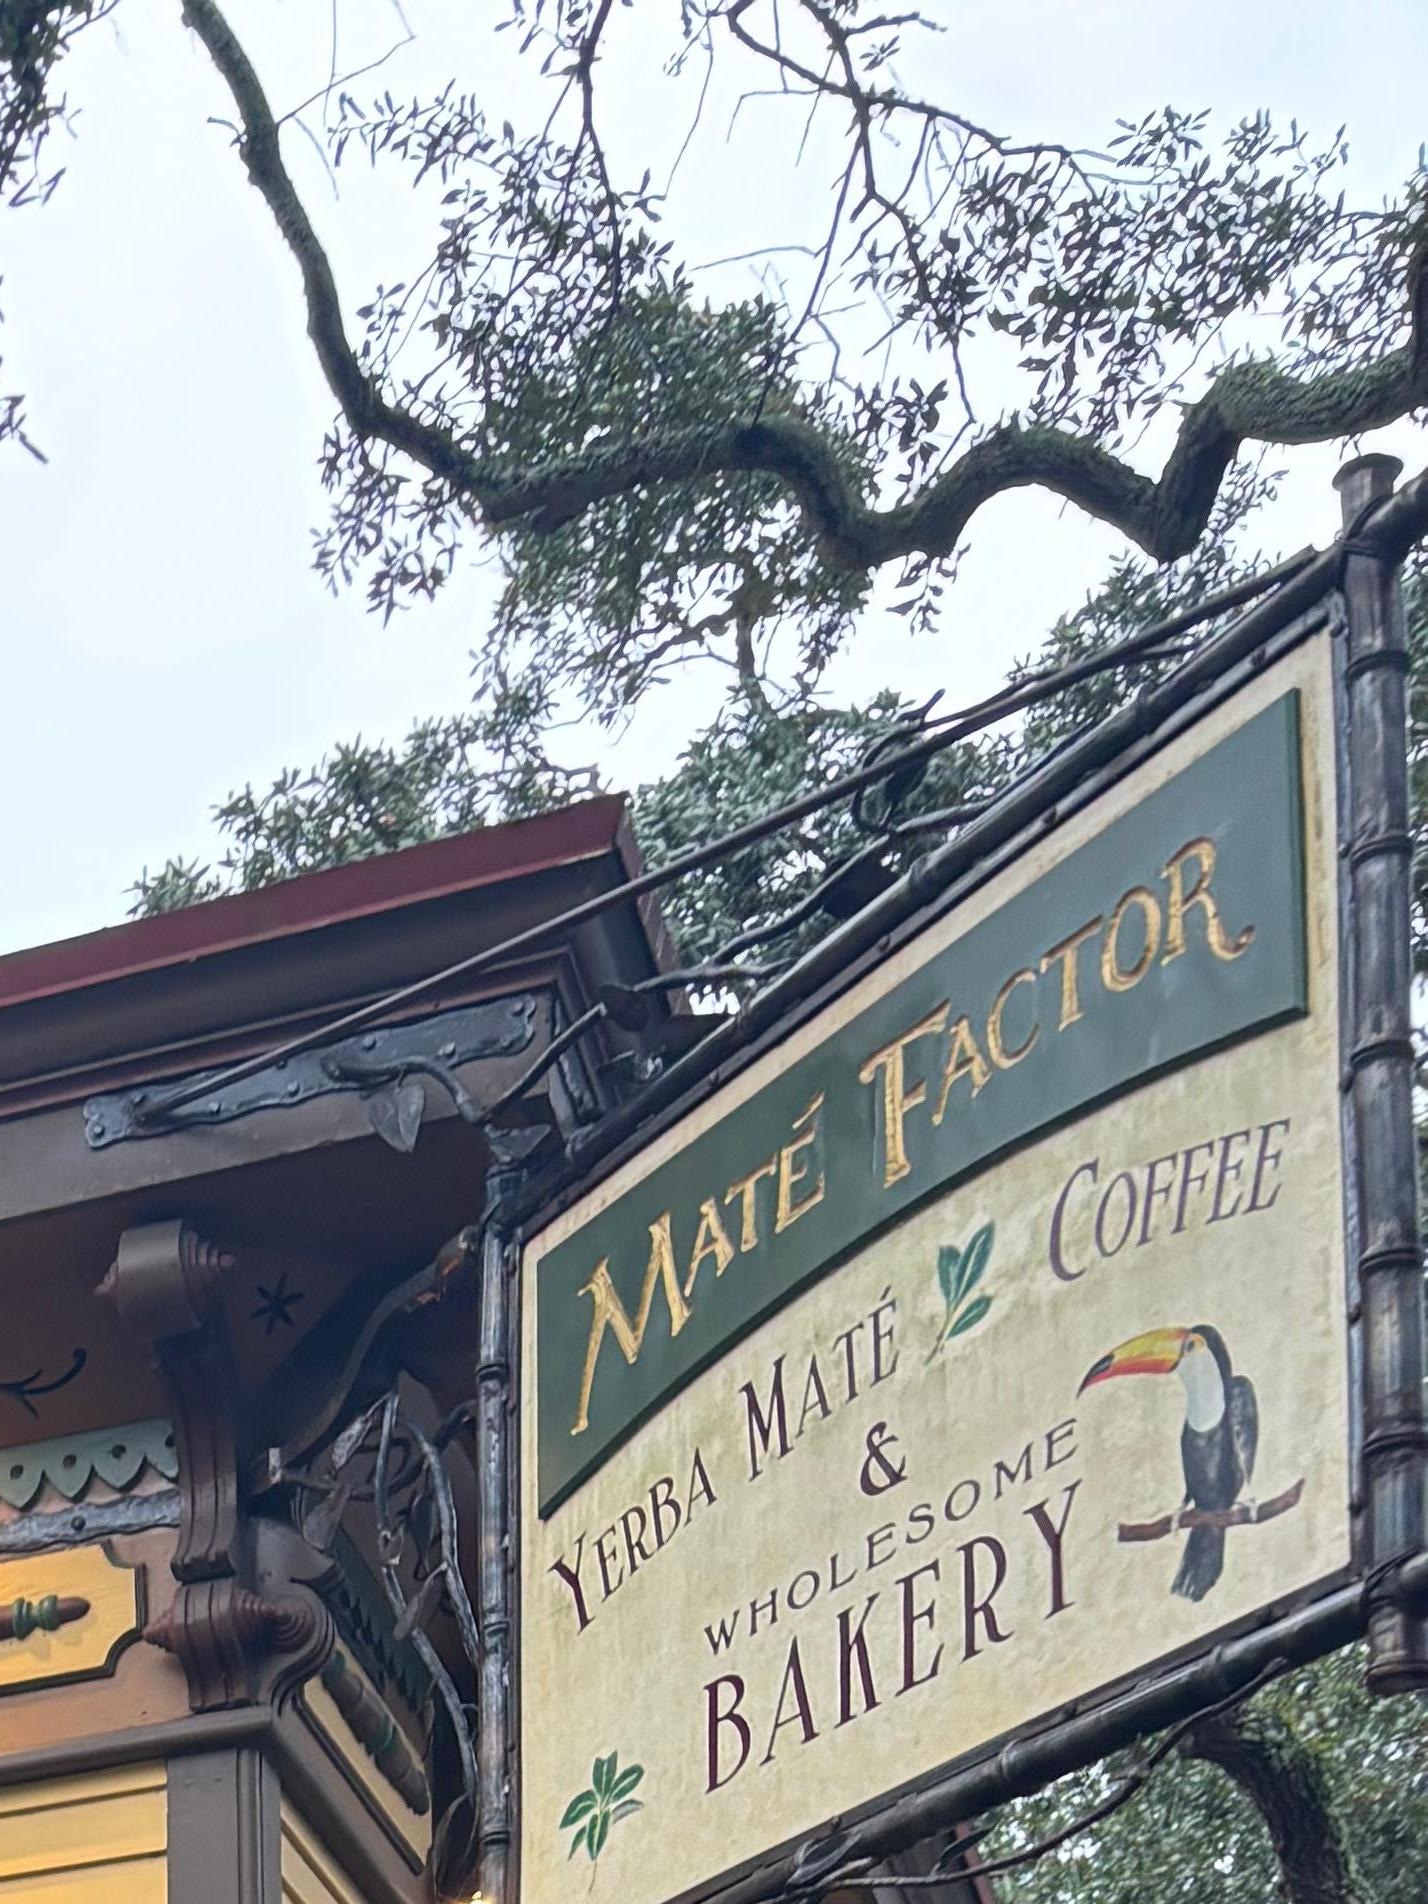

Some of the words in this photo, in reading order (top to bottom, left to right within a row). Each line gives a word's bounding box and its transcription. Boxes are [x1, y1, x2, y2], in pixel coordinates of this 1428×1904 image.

[572, 1094, 827, 1436] MATÉ
[858, 834, 1258, 1190] FACTOR
[1048, 1117, 1293, 1285] COFFEE
[547, 1446, 720, 1637] YERBA
[737, 1283, 901, 1487] MATÉ
[703, 1417, 1082, 1655] WHOLESOME
[858, 1420, 910, 1497] &
[702, 1480, 1088, 1796] BAKERY
